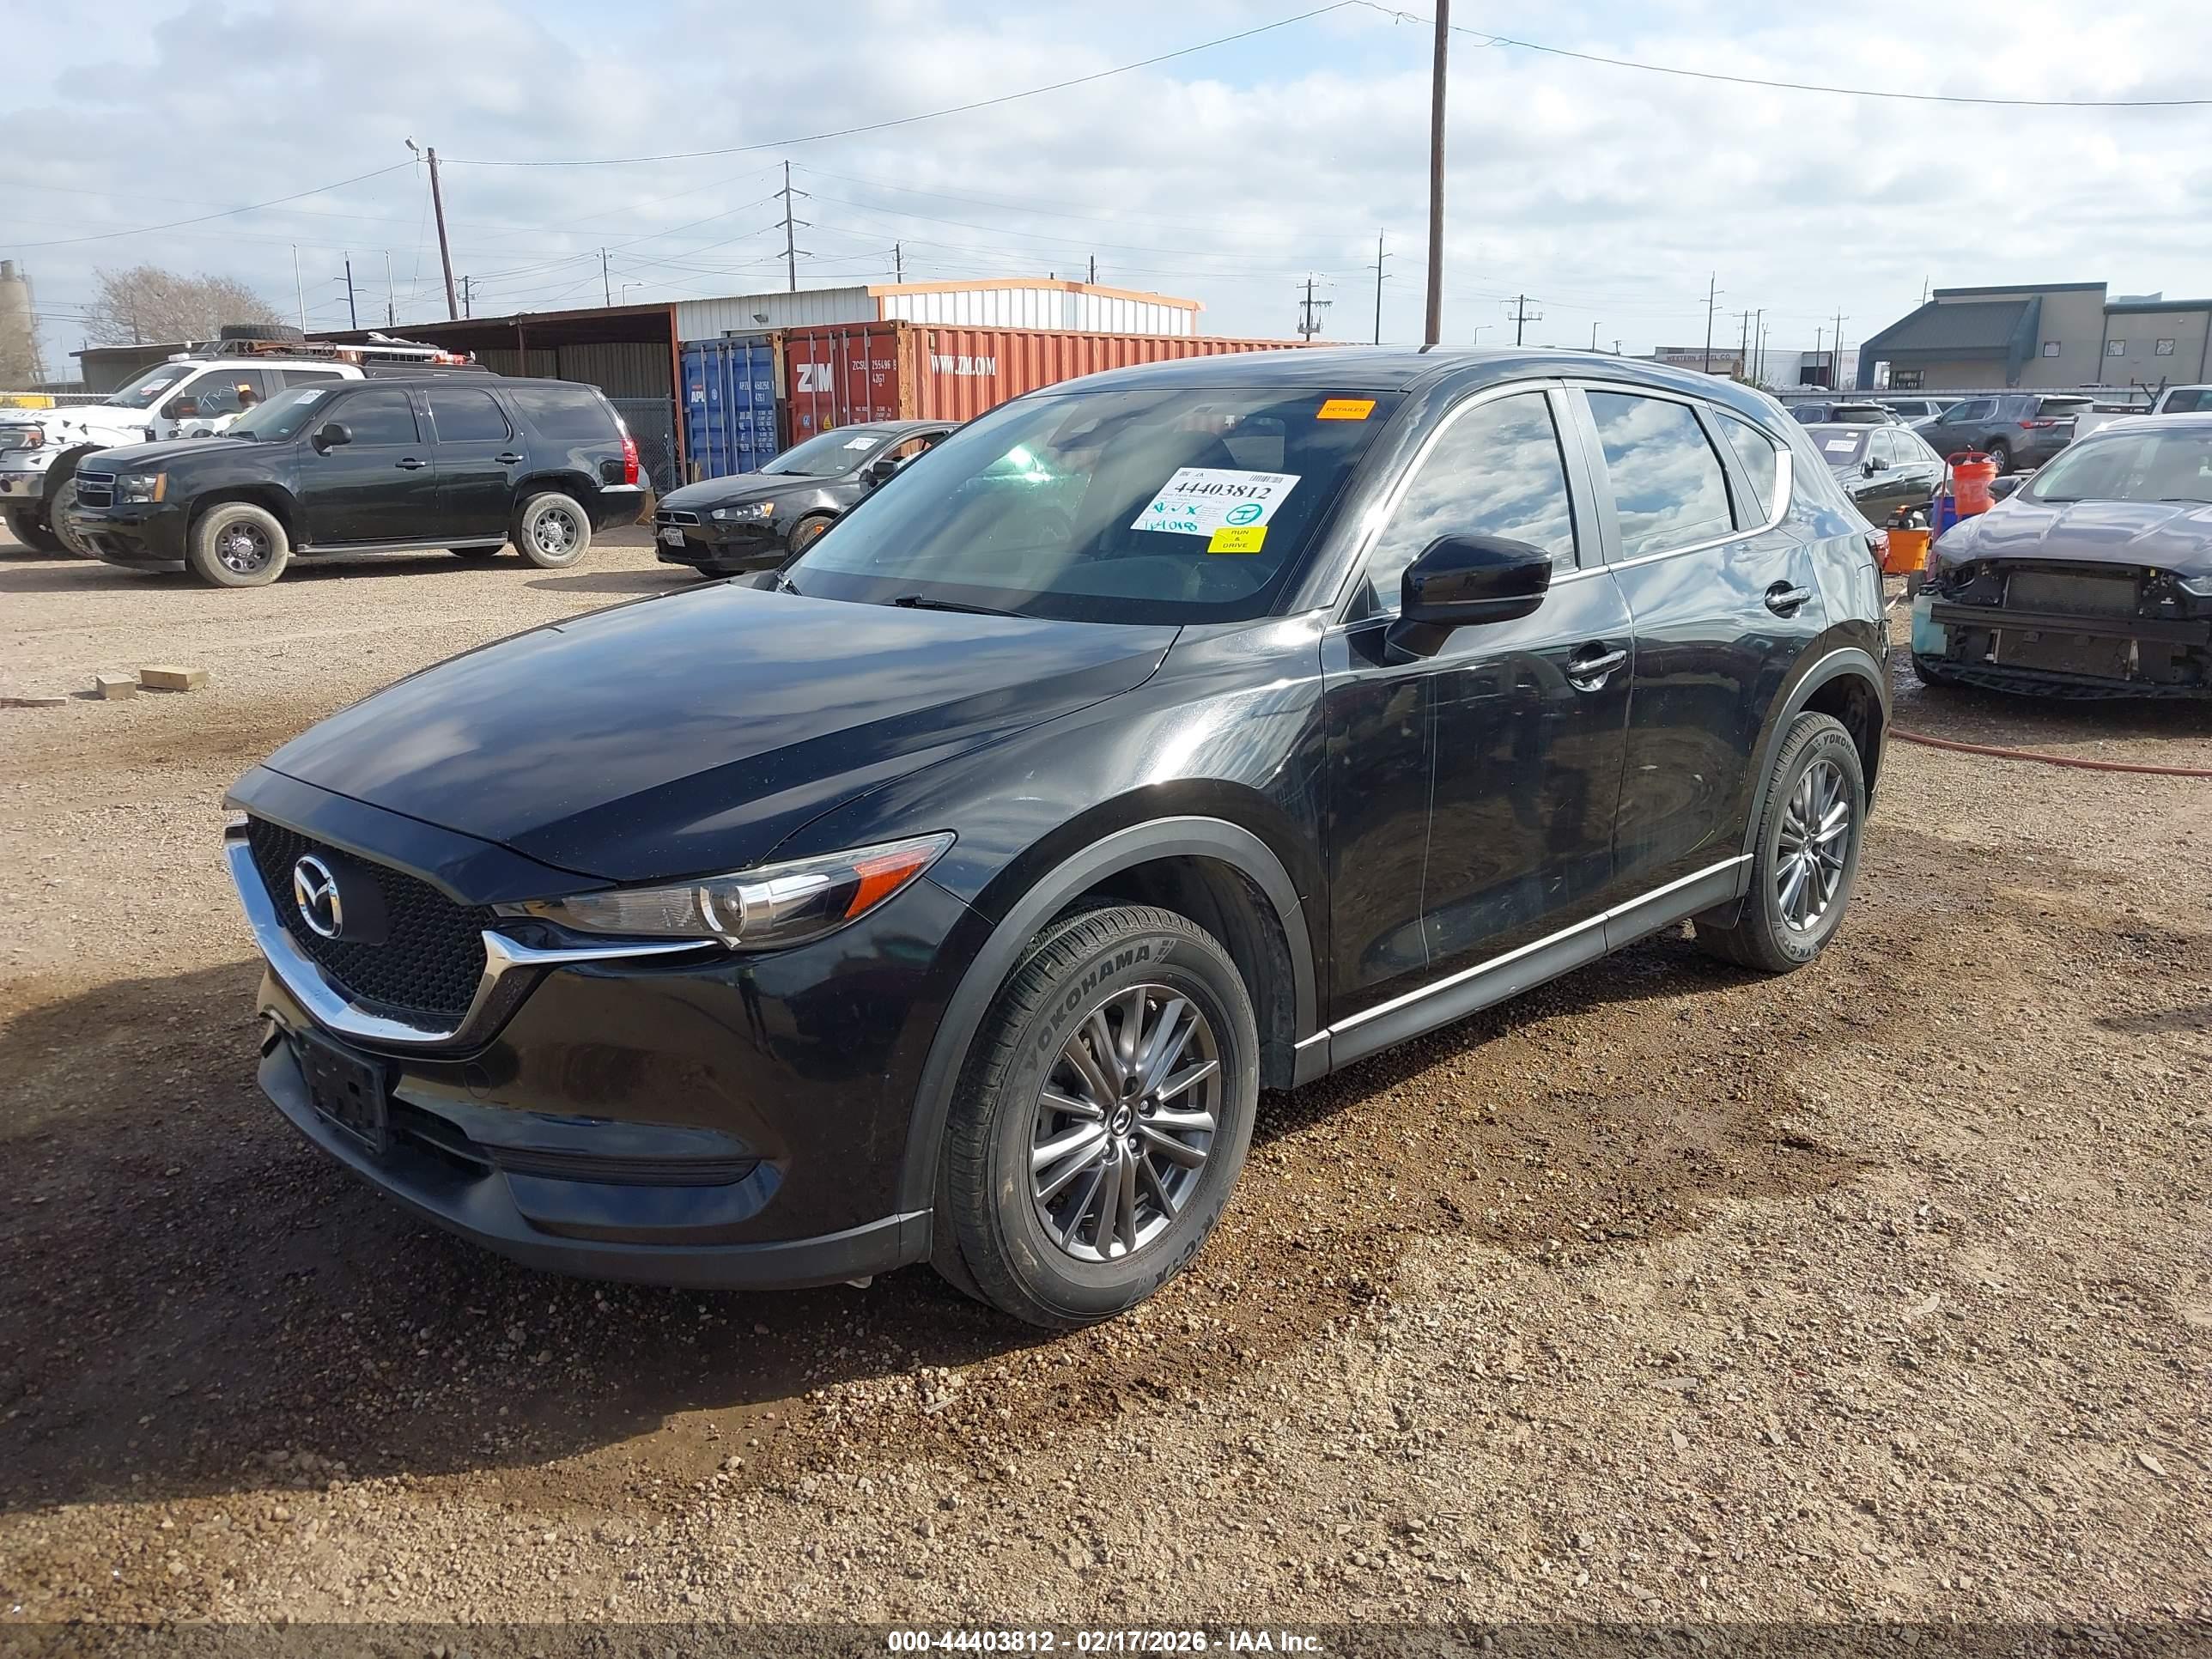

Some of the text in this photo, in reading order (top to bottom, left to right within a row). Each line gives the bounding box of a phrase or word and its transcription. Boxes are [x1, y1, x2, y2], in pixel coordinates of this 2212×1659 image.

[796, 362, 833, 392] ZIM
[1175, 481, 1273, 500] 44403812
[1024, 945, 1150, 1071] YOKOHAMA
